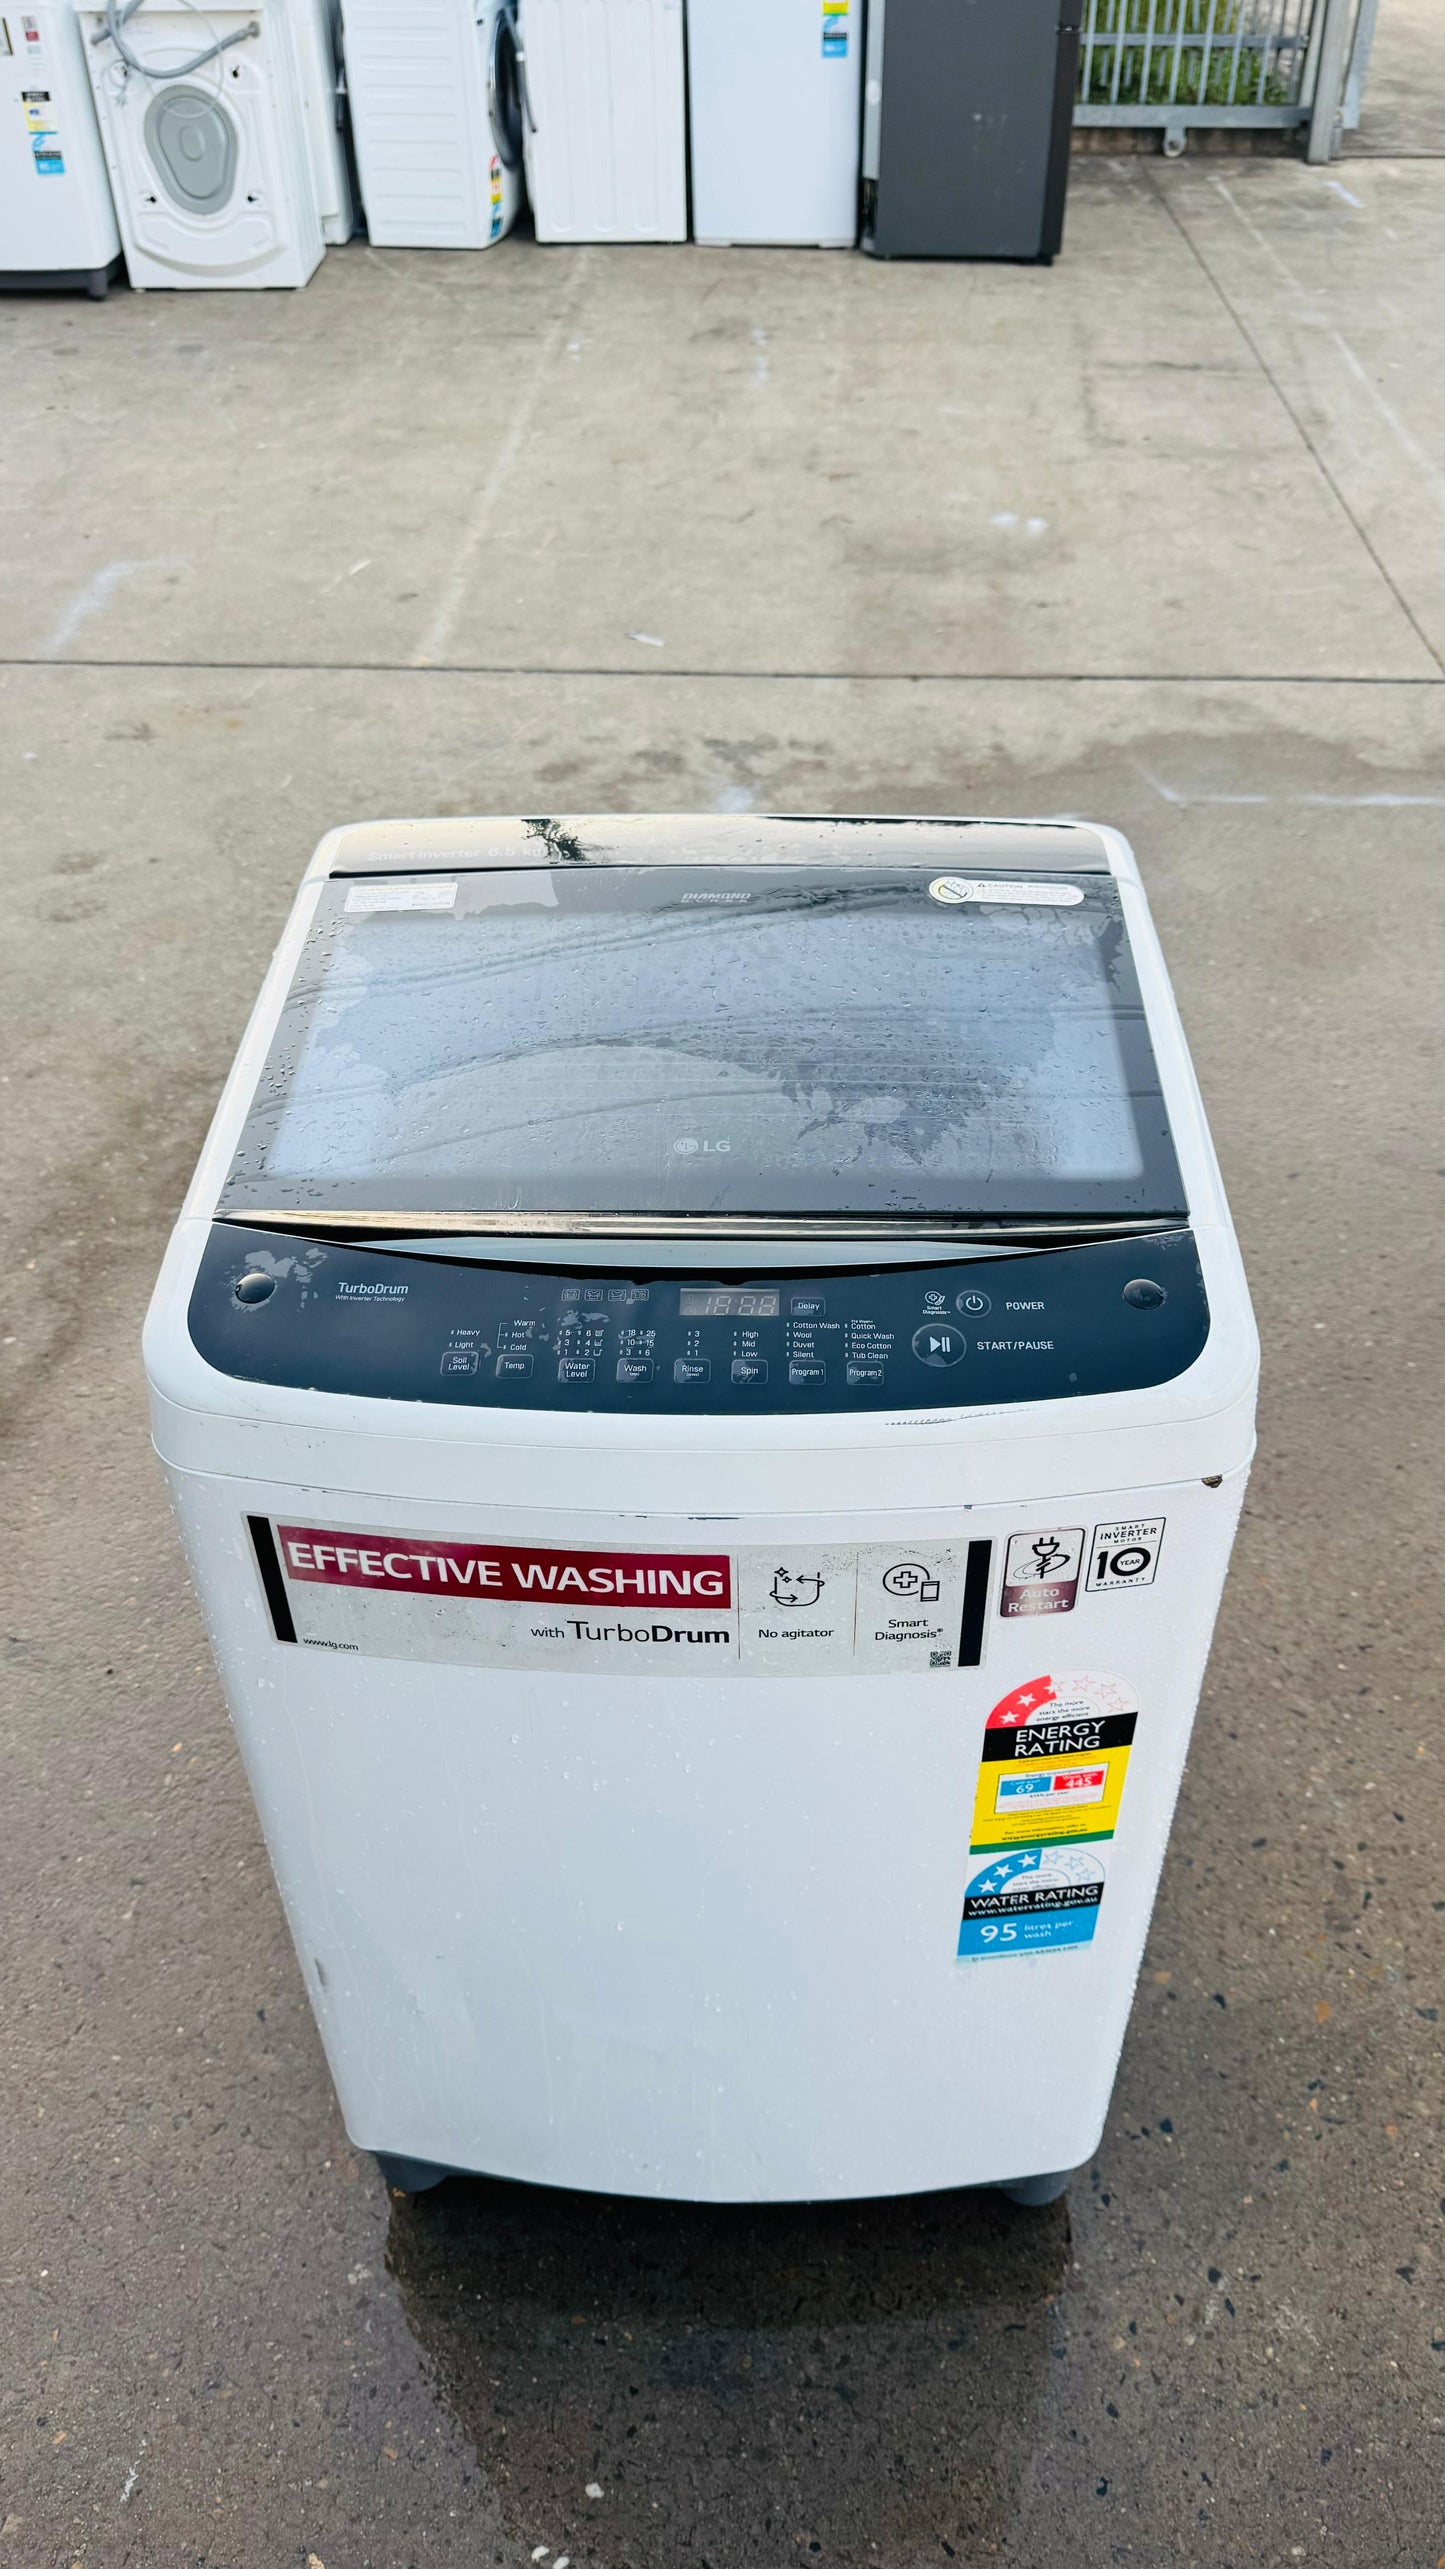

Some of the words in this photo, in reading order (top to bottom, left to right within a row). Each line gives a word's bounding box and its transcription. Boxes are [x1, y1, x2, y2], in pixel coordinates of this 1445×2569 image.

[368, 851, 415, 862] Smart
[420, 849, 480, 860] Inverter
[488, 848, 515, 858] 6.5
[703, 1140, 731, 1152] LG
[338, 1282, 409, 1294] TurboDrum
[798, 1302, 820, 1311] Delay
[1006, 1301, 1045, 1310] POWER
[742, 1330, 759, 1338] High
[851, 1332, 872, 1340] Quick
[454, 1341, 474, 1349] Light
[646, 1339, 655, 1347] 15
[866, 1342, 892, 1350] Cotton
[977, 1341, 1054, 1350] START/PAUSE
[452, 1356, 468, 1364] Soil
[564, 1362, 590, 1370] Water
[624, 1364, 647, 1372] Wash
[740, 1366, 759, 1375] Spin
[566, 1370, 588, 1378] Level
[849, 1370, 878, 1378] Program
[1100, 1527, 1157, 1540] INVERTER
[1096, 1546, 1152, 1580] 10
[1120, 1558, 1140, 1566] YEAR
[287, 1541, 503, 1587] EFFECTIVE
[511, 1562, 724, 1596] WASHING
[1096, 1577, 1146, 1587] WARRANTY
[1020, 1588, 1060, 1600] Auto
[1008, 1600, 1069, 1613] Restart
[888, 1618, 929, 1628] Smart
[530, 1626, 565, 1639] with
[566, 1620, 730, 1644] TurboDrum
[758, 1629, 778, 1638] No
[782, 1629, 835, 1640] agitator
[303, 1638, 359, 1651] www.lg.com
[1016, 1720, 1106, 1743] ENERGY
[1014, 1736, 1100, 1757] RATING
[1065, 1776, 1093, 1788] 445
[1016, 1784, 1034, 1794] 69
[970, 1894, 1029, 1909] WATER
[1034, 1886, 1100, 1902] RATING
[968, 1896, 1098, 1917] www.waterrating.gov.au
[1054, 1920, 1074, 1930] per
[980, 1922, 1018, 1944] 95
[1024, 1930, 1052, 1940] wash
